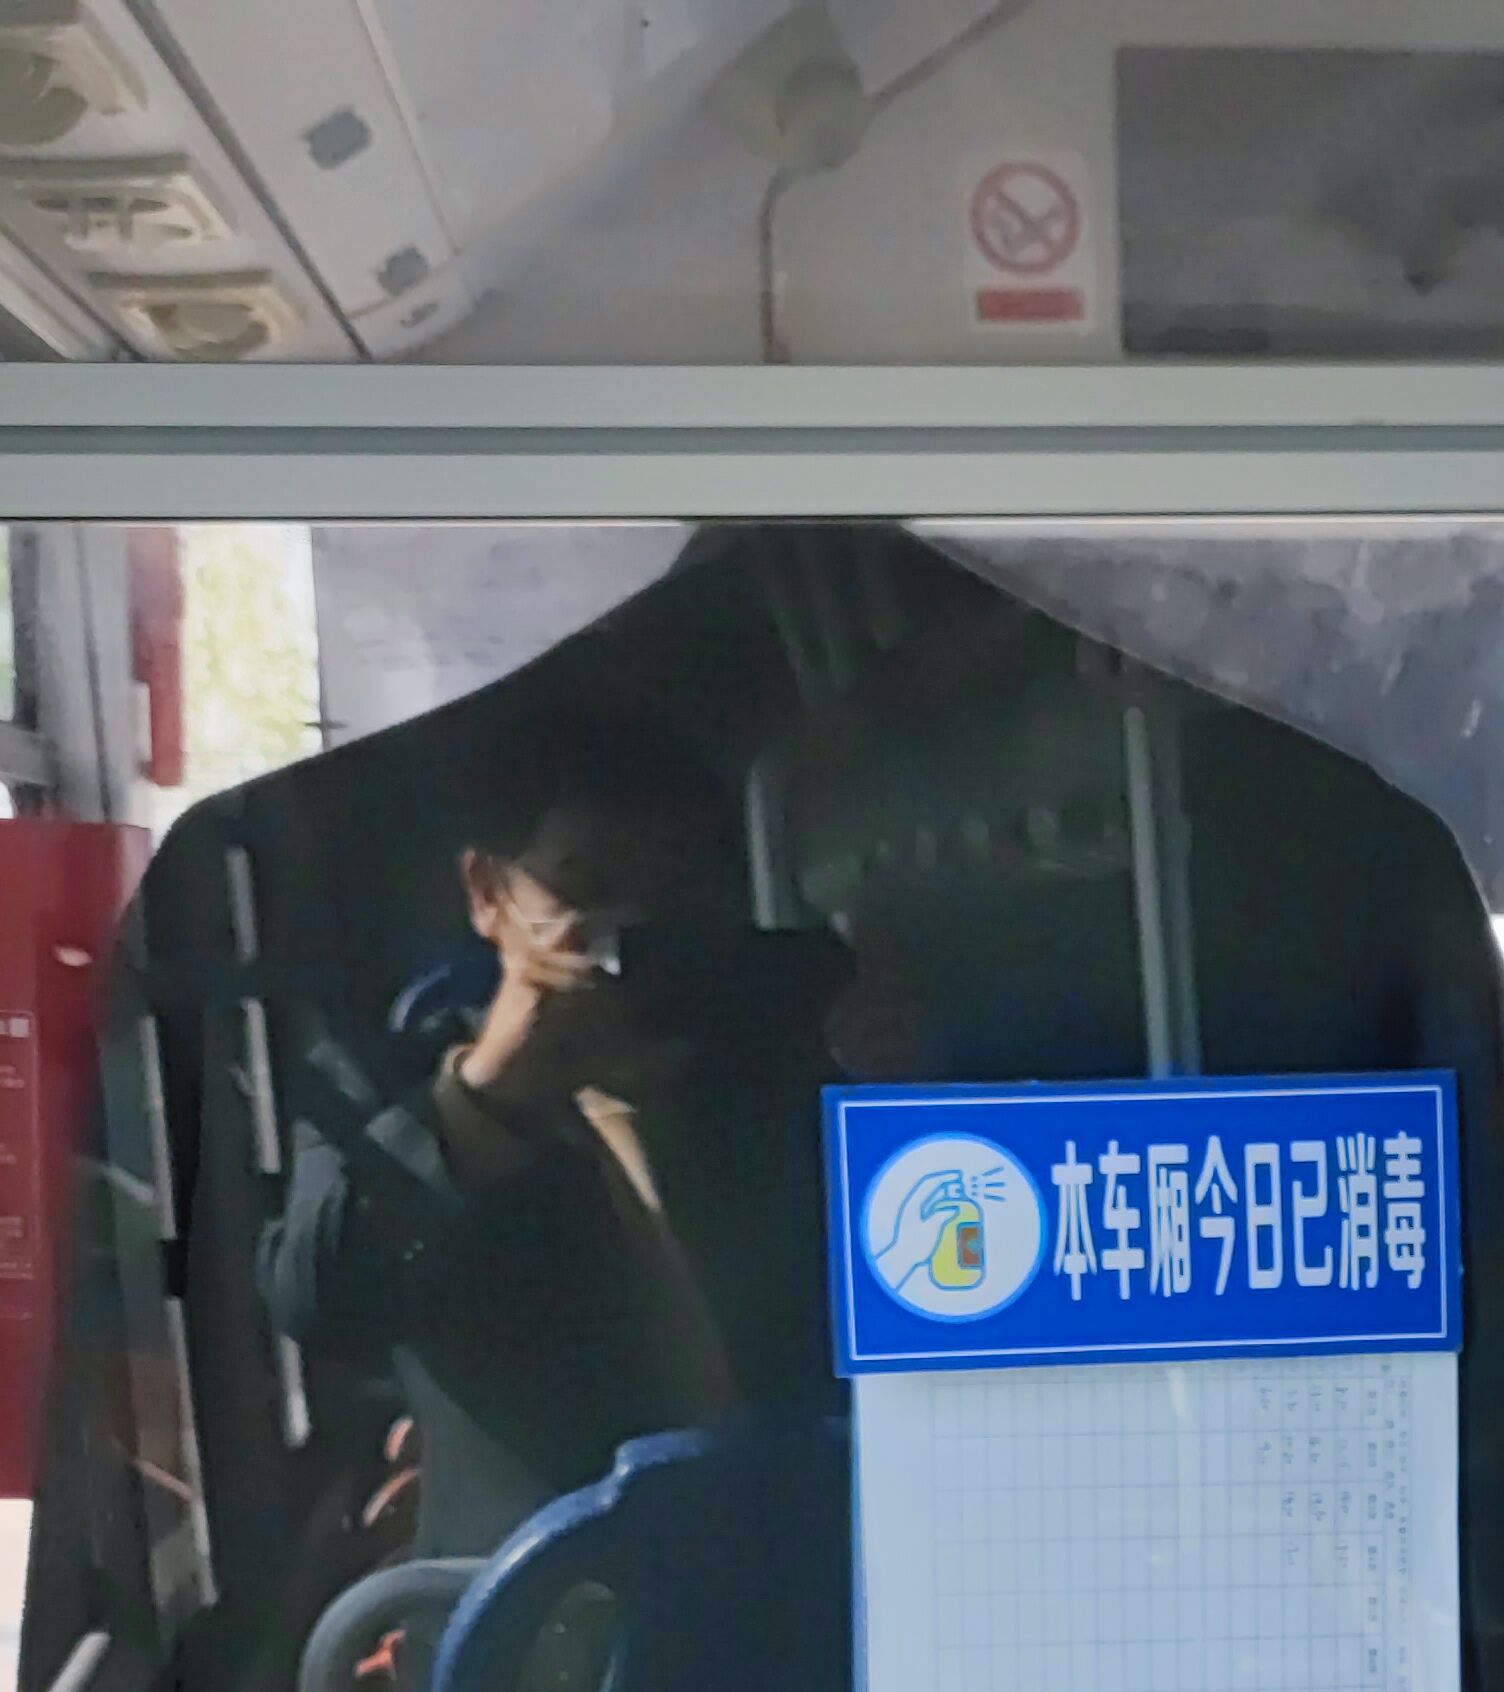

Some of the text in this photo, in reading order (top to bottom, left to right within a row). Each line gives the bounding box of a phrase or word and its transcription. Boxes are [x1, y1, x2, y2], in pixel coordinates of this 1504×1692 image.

[1050, 1131, 1427, 1301] 本车厢今日已消毒
